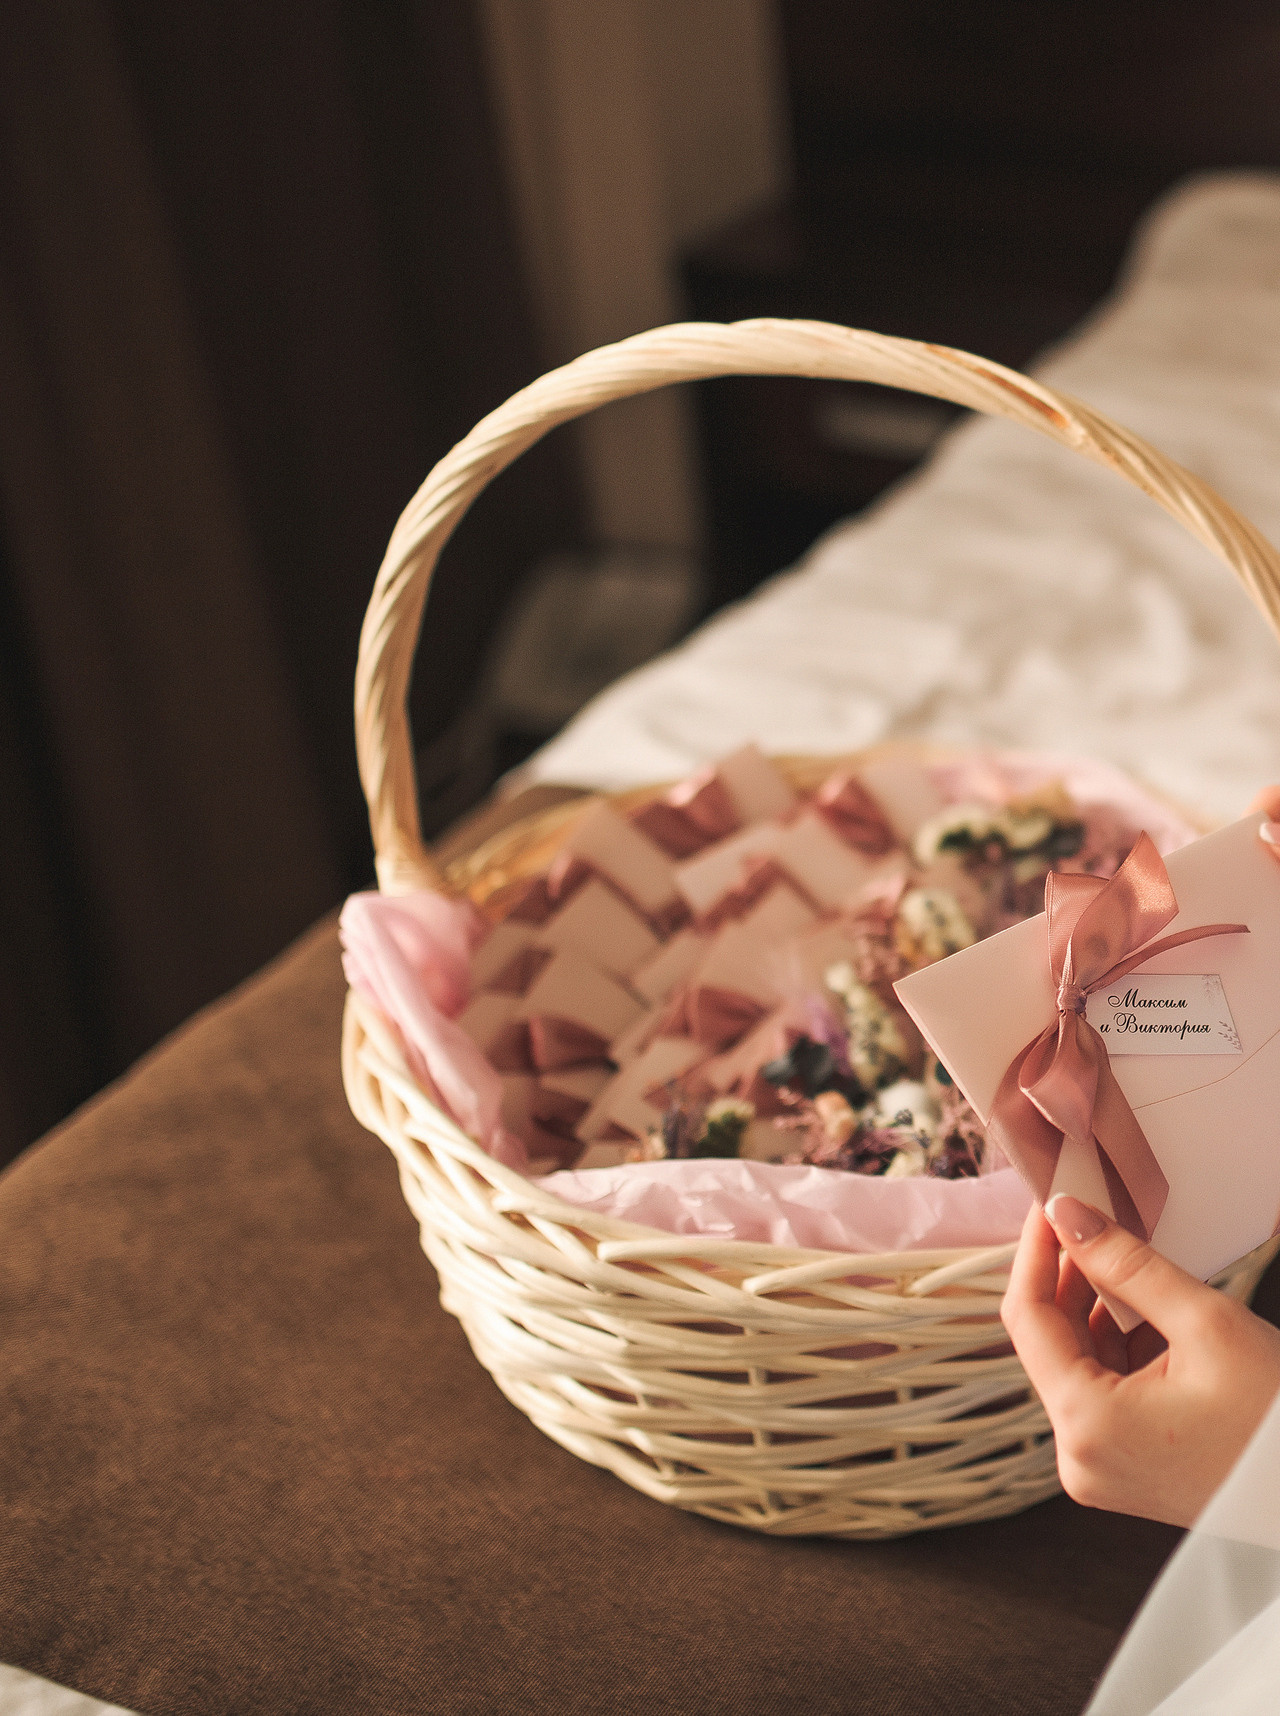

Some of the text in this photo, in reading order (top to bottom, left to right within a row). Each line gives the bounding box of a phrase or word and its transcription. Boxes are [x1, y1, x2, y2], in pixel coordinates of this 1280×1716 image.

[1107, 988, 1188, 1008] Максим
[1099, 1012, 1211, 1040] и Виктория
